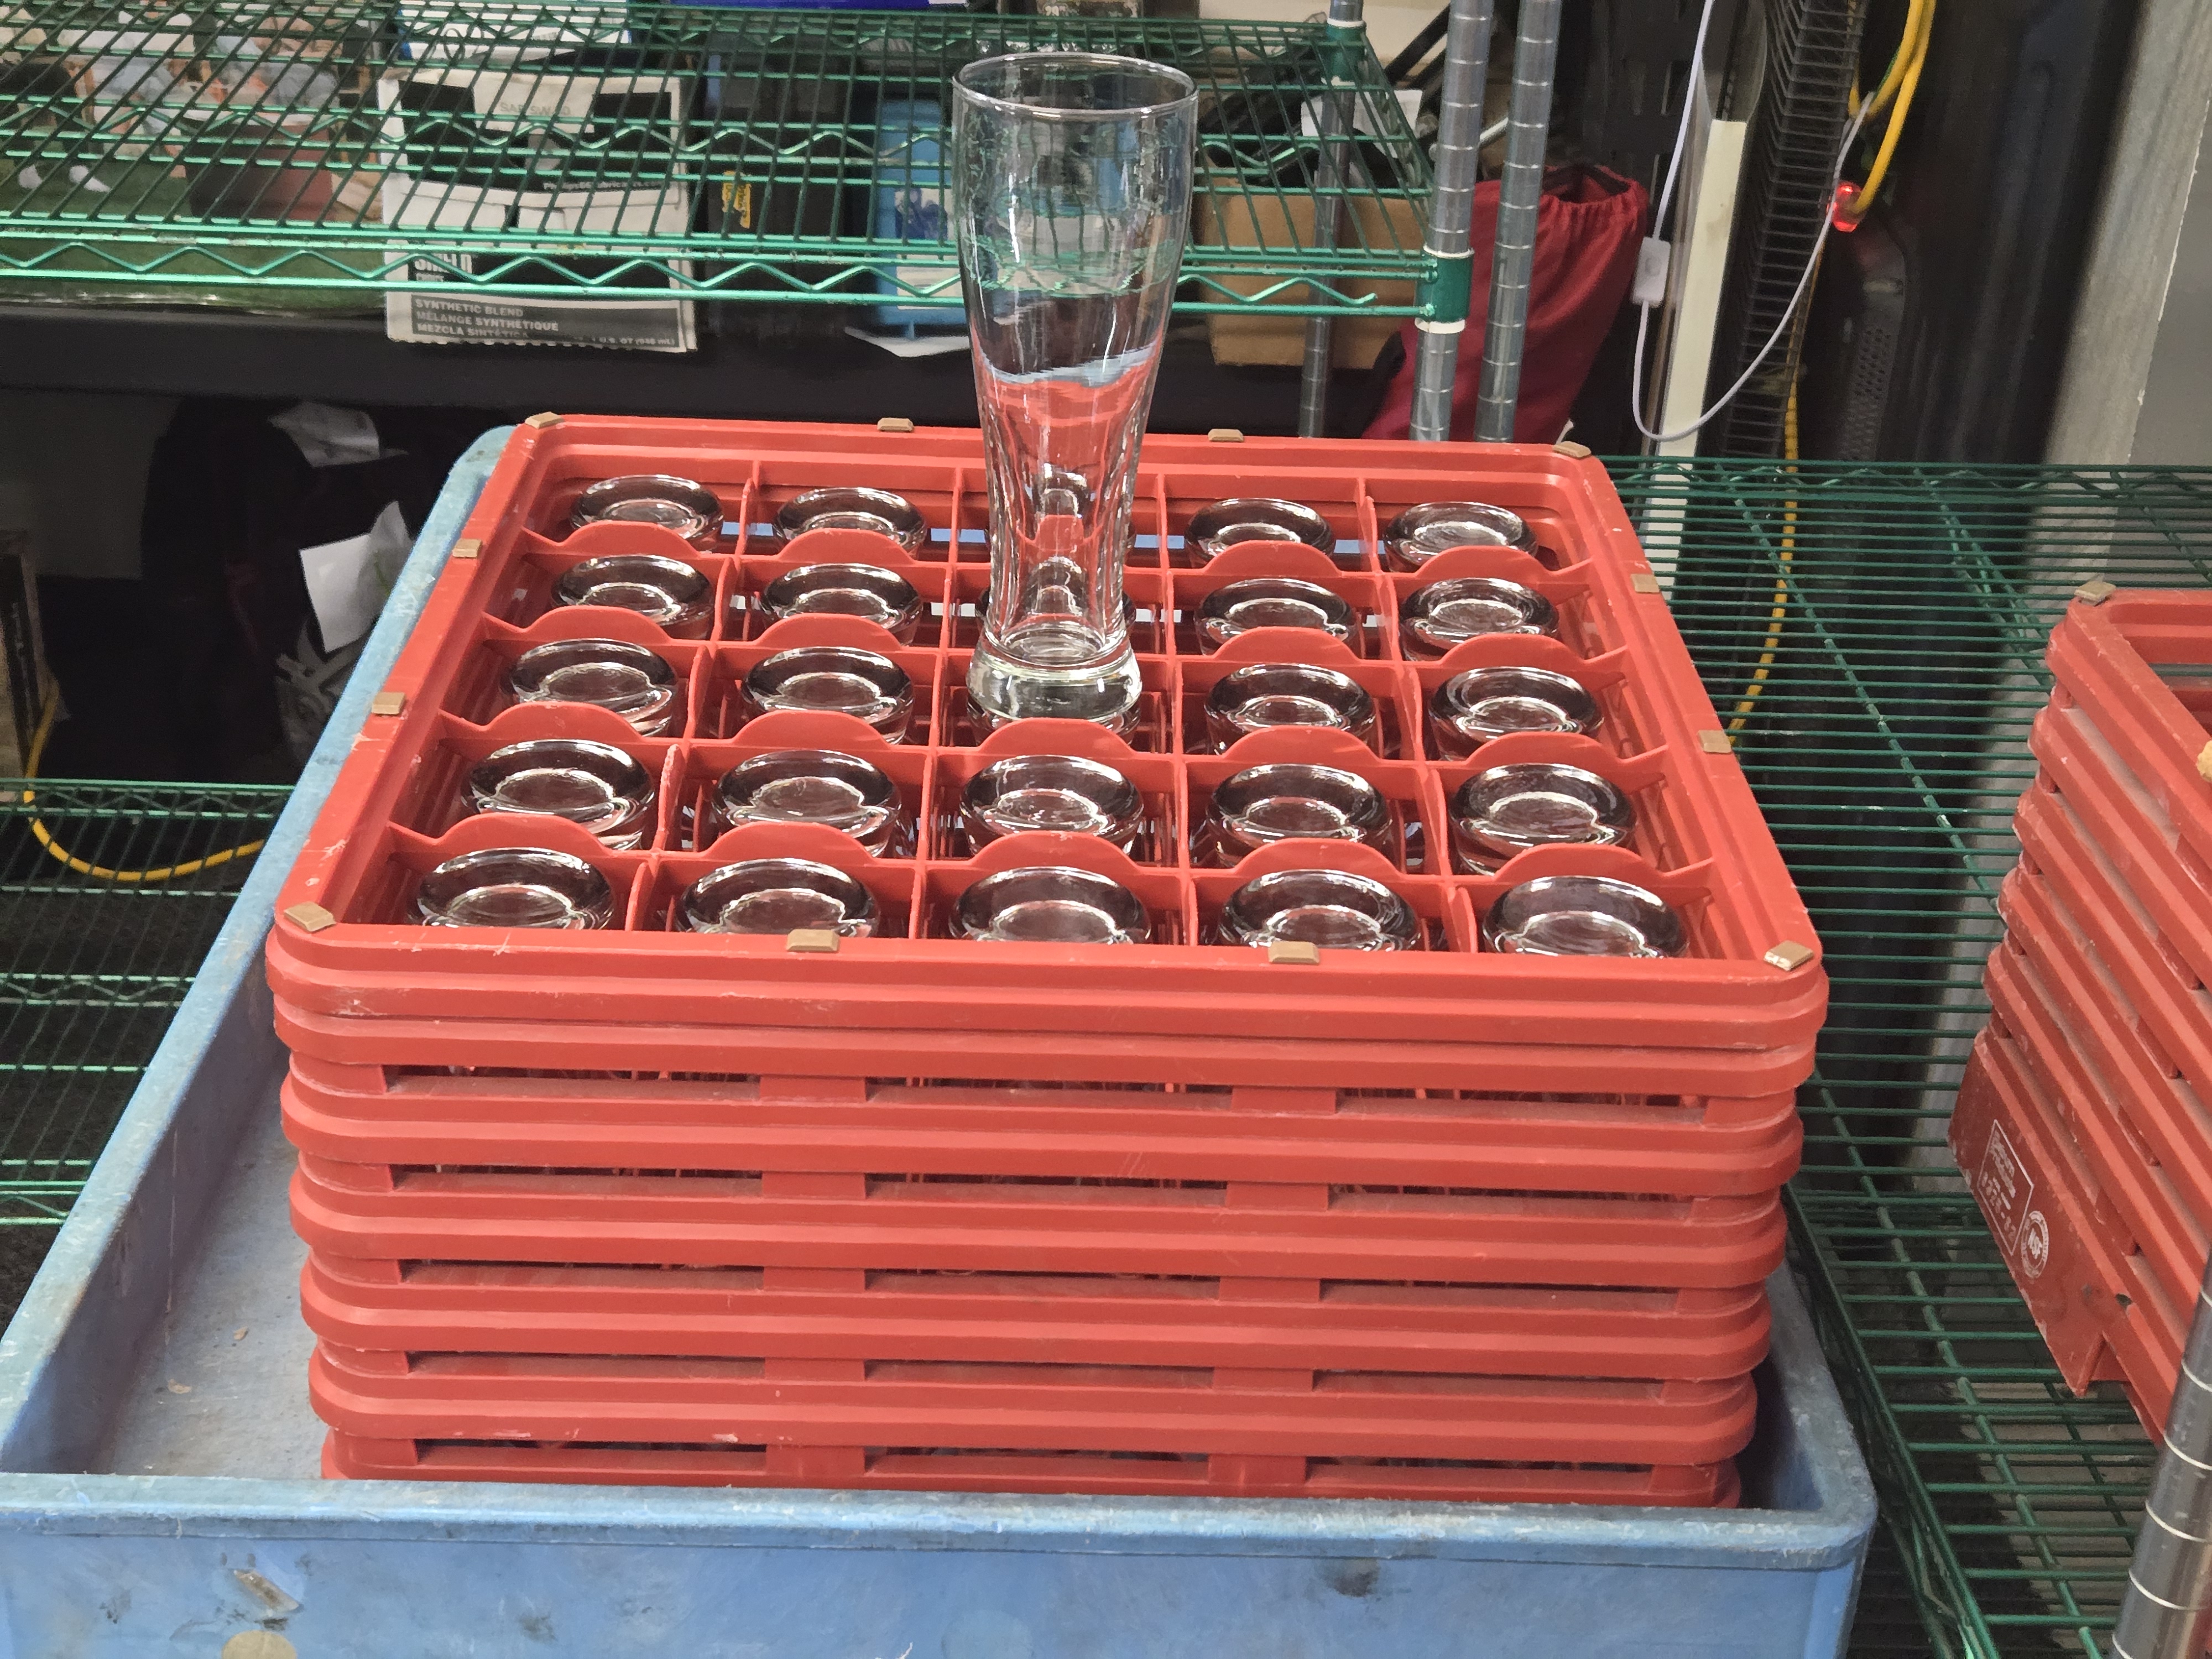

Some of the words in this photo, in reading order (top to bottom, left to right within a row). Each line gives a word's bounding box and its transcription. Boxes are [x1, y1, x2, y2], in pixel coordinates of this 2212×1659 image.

[415, 299, 482, 314] SYNTHETIC
[485, 306, 523, 317] BLEND
[416, 322, 464, 335] MEZCLA
